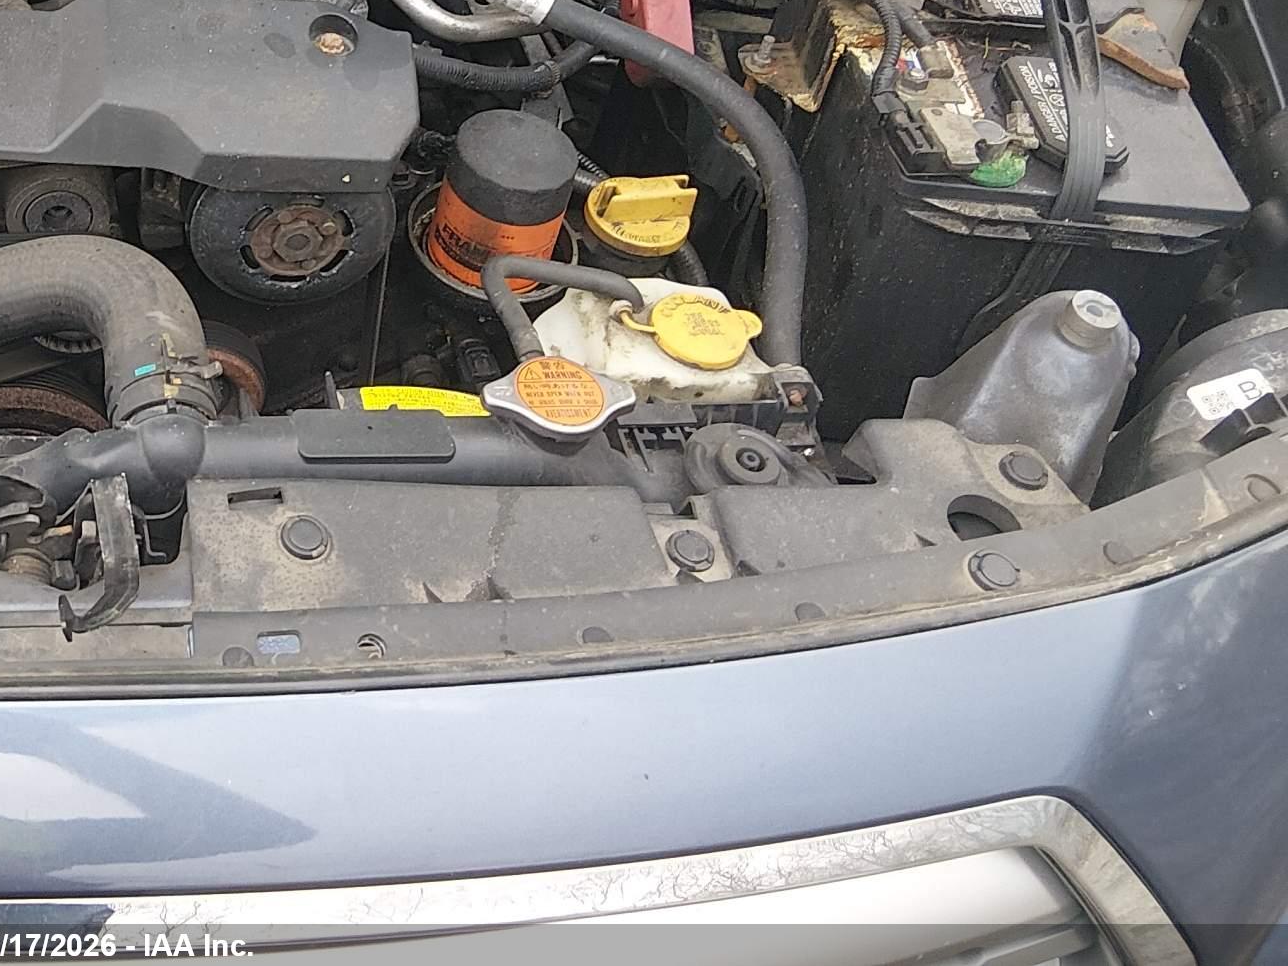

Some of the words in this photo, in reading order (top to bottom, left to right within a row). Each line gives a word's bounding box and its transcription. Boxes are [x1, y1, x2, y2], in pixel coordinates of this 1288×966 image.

[1019, 65, 1041, 95] POISON
[1037, 101, 1062, 134] DANGER
[542, 370, 583, 380] WARNING
[1237, 380, 1263, 401] B
